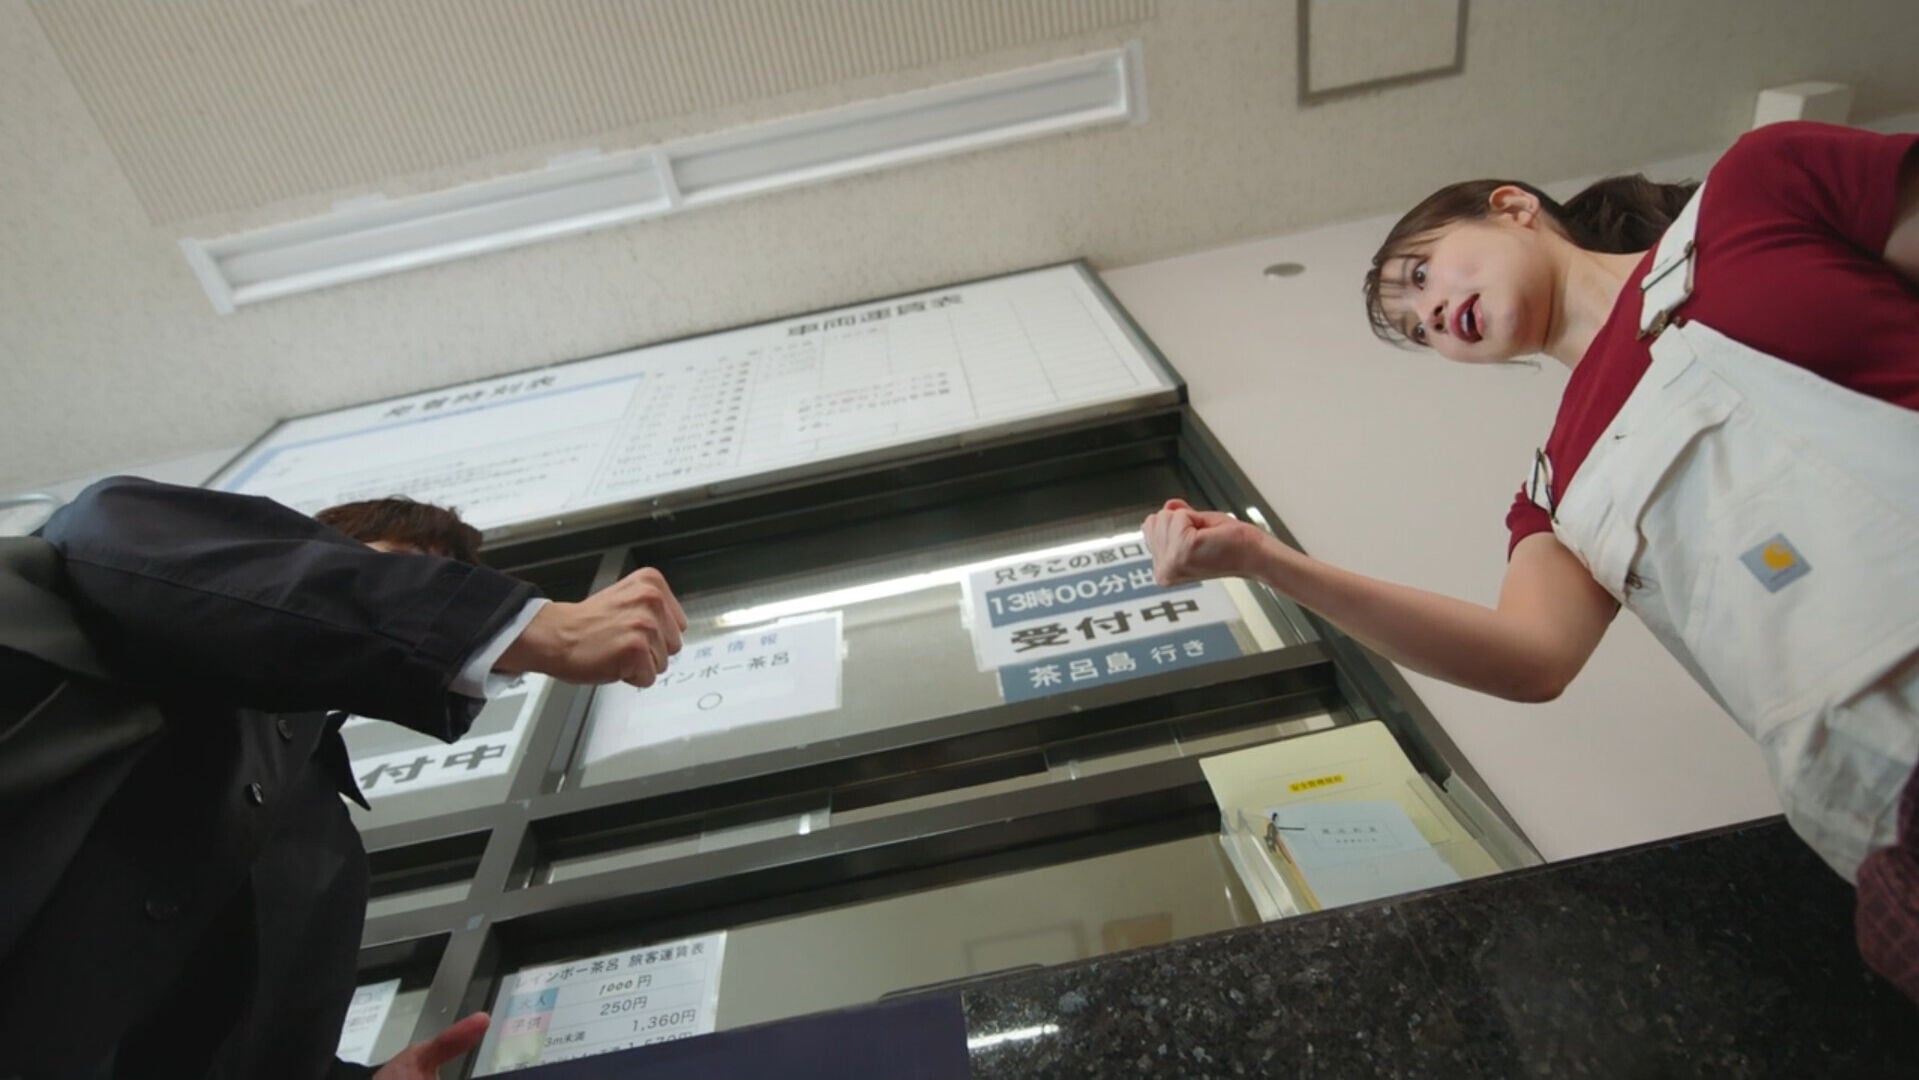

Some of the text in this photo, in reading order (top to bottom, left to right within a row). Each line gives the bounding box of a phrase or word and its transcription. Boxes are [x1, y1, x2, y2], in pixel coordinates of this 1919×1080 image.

[995, 543, 1144, 584] 只今この窓口
[1011, 600, 1199, 653] 受付中
[636, 651, 790, 692] インボー茶呂
[1029, 640, 1205, 688] 茶呂島 行き
[600, 995, 648, 1017] 250円
